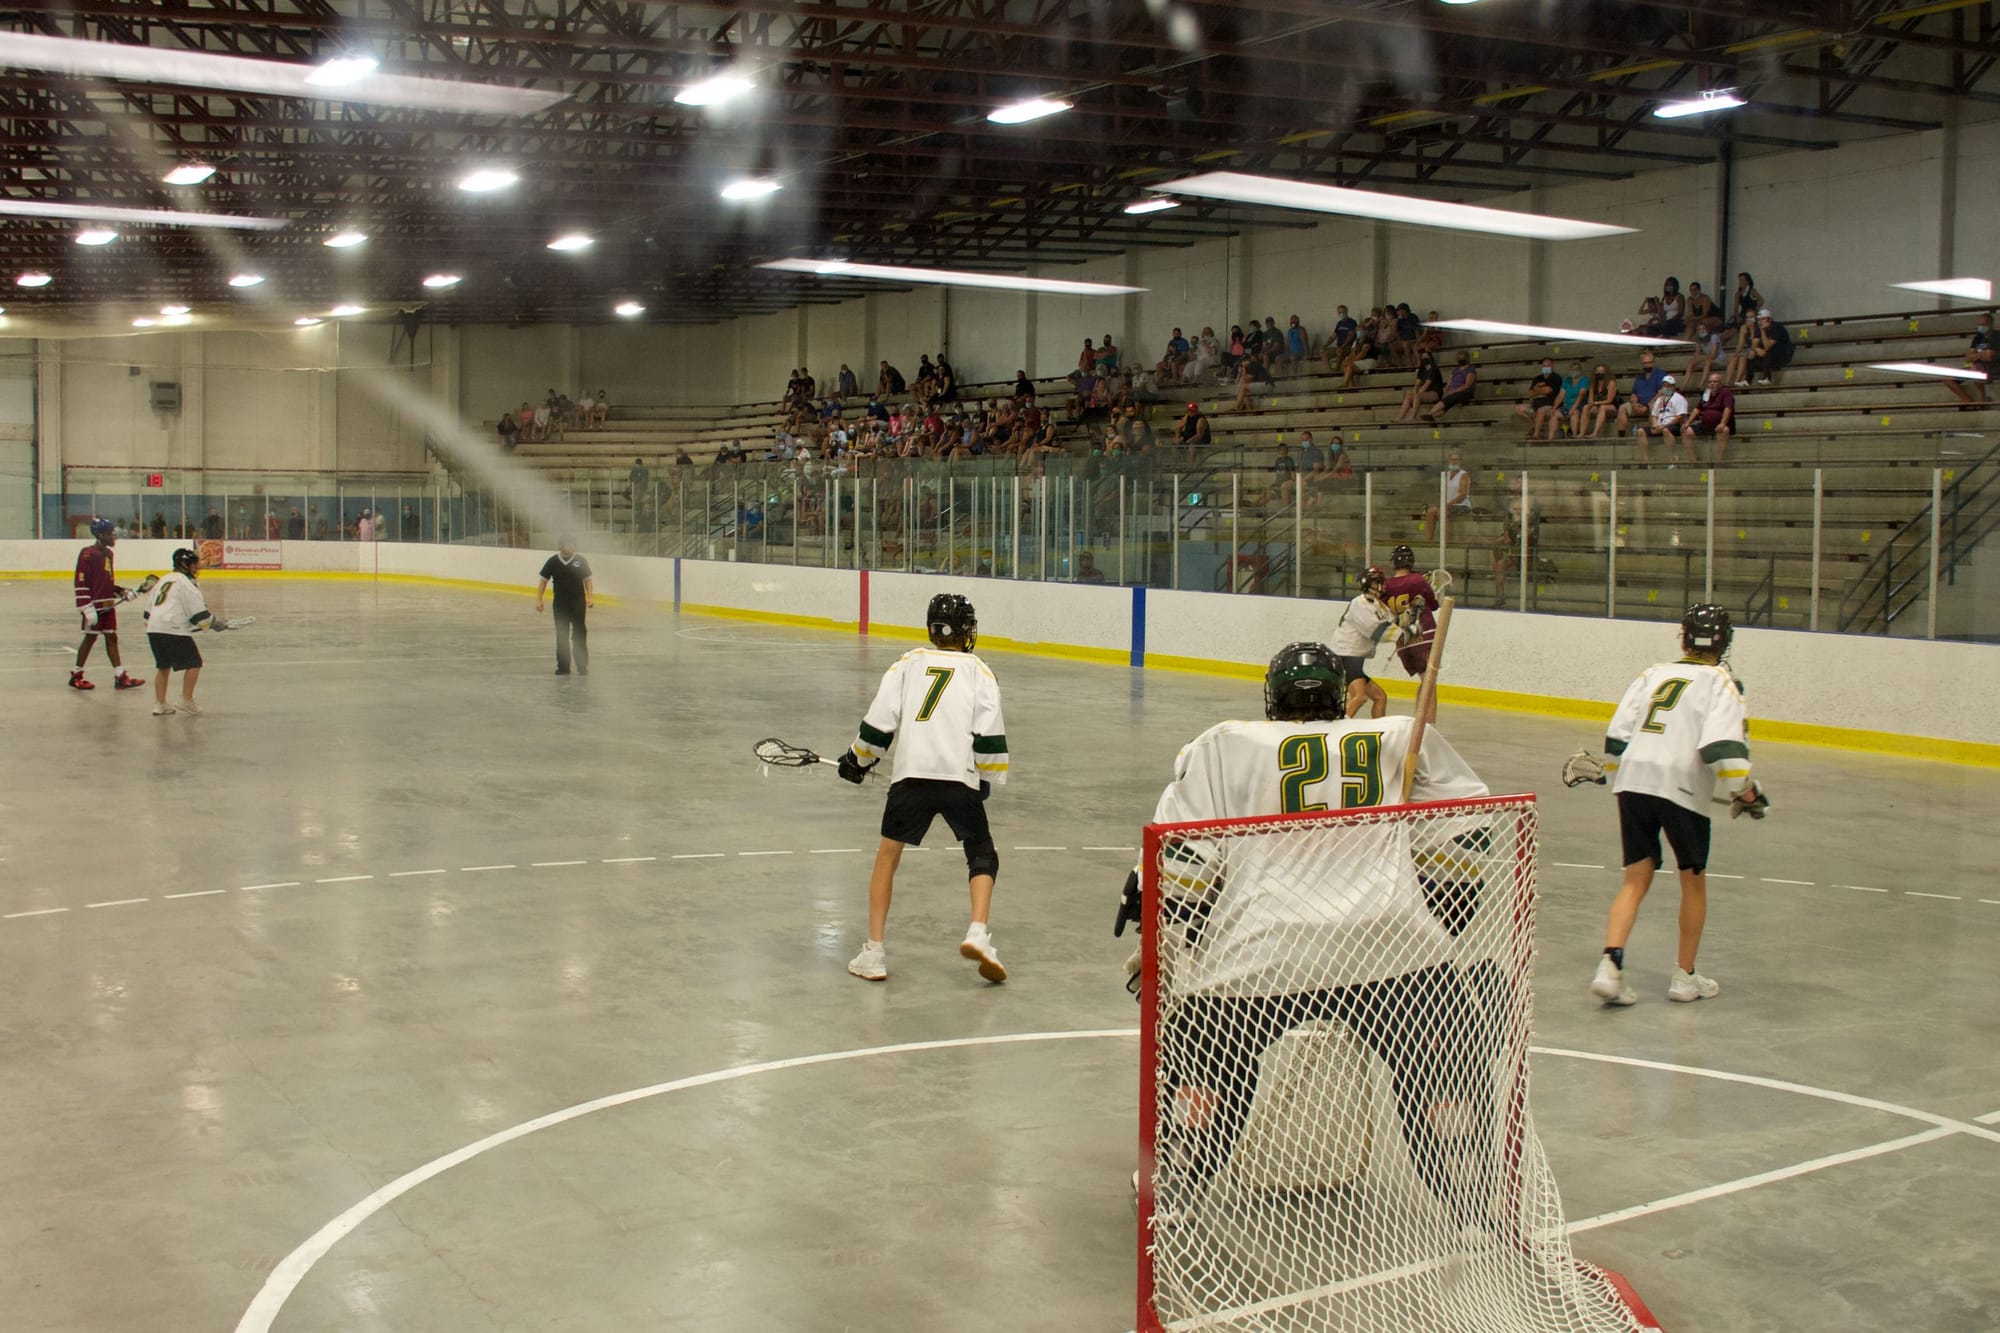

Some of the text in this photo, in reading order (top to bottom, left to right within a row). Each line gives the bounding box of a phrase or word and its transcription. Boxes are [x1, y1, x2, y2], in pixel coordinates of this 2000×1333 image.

[915, 666, 955, 721] 7
[1640, 677, 1693, 734] 2
[1279, 732, 1384, 814] 29
